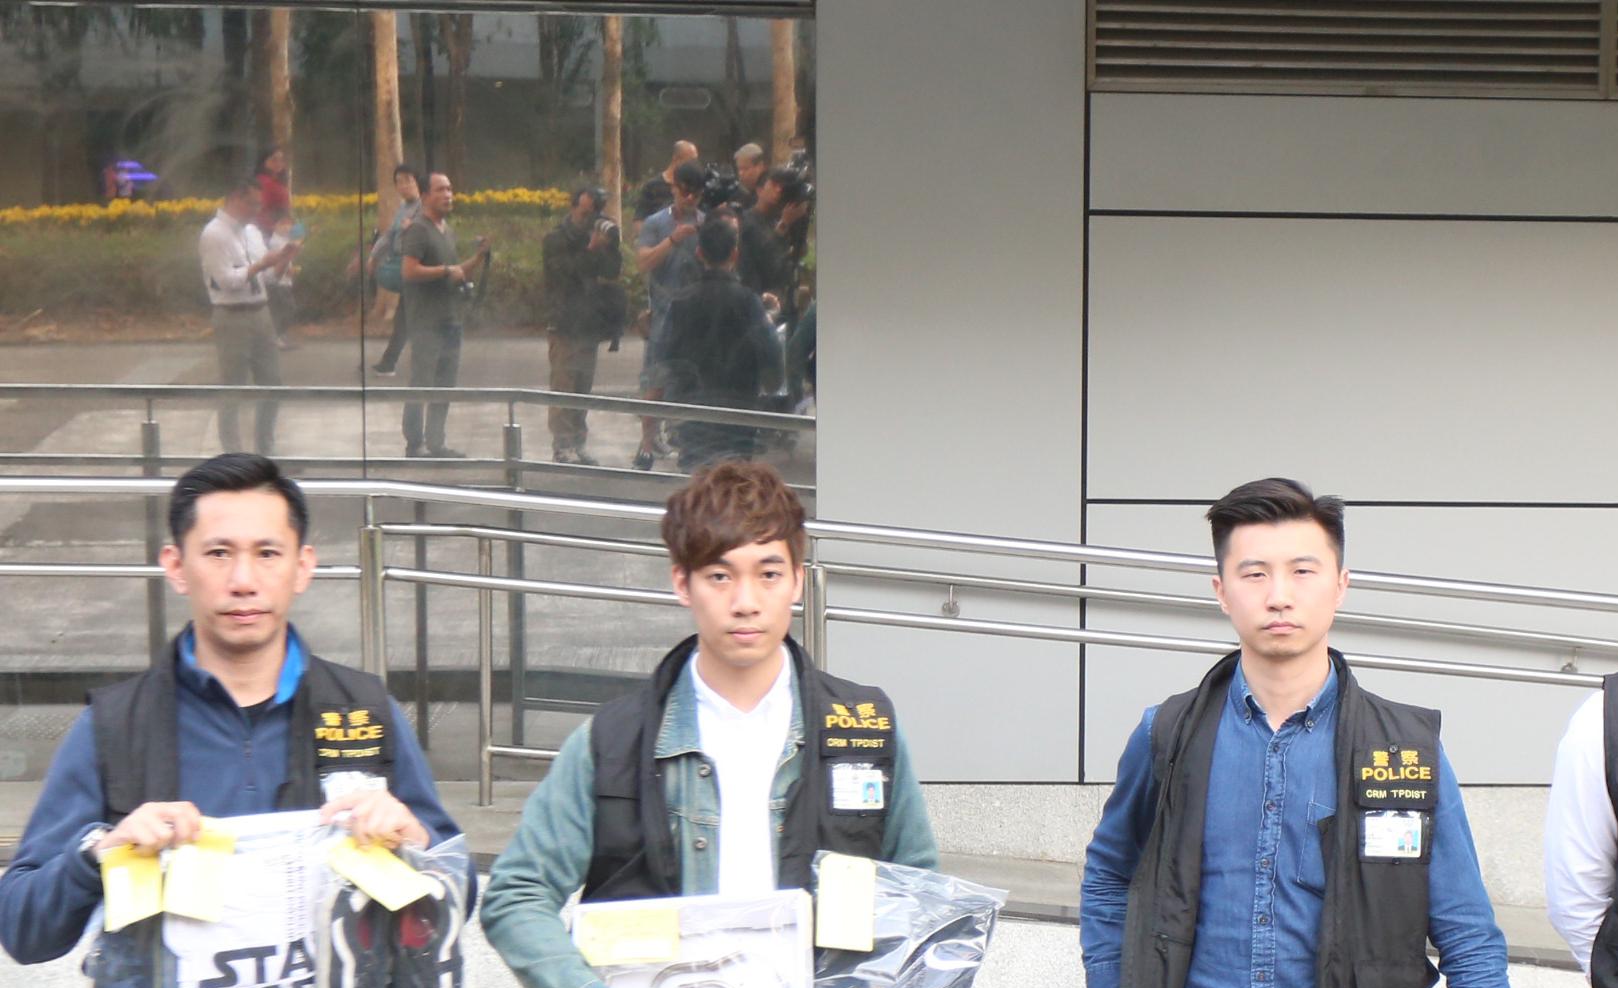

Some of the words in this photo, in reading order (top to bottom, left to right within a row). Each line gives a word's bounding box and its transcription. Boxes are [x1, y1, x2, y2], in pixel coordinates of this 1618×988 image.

[826, 715, 891, 729] POLICE
[314, 725, 384, 741] POLICE
[1361, 766, 1432, 781] POLICE
[1366, 789, 1387, 799] CRM
[1390, 790, 1427, 799] TPDIST
